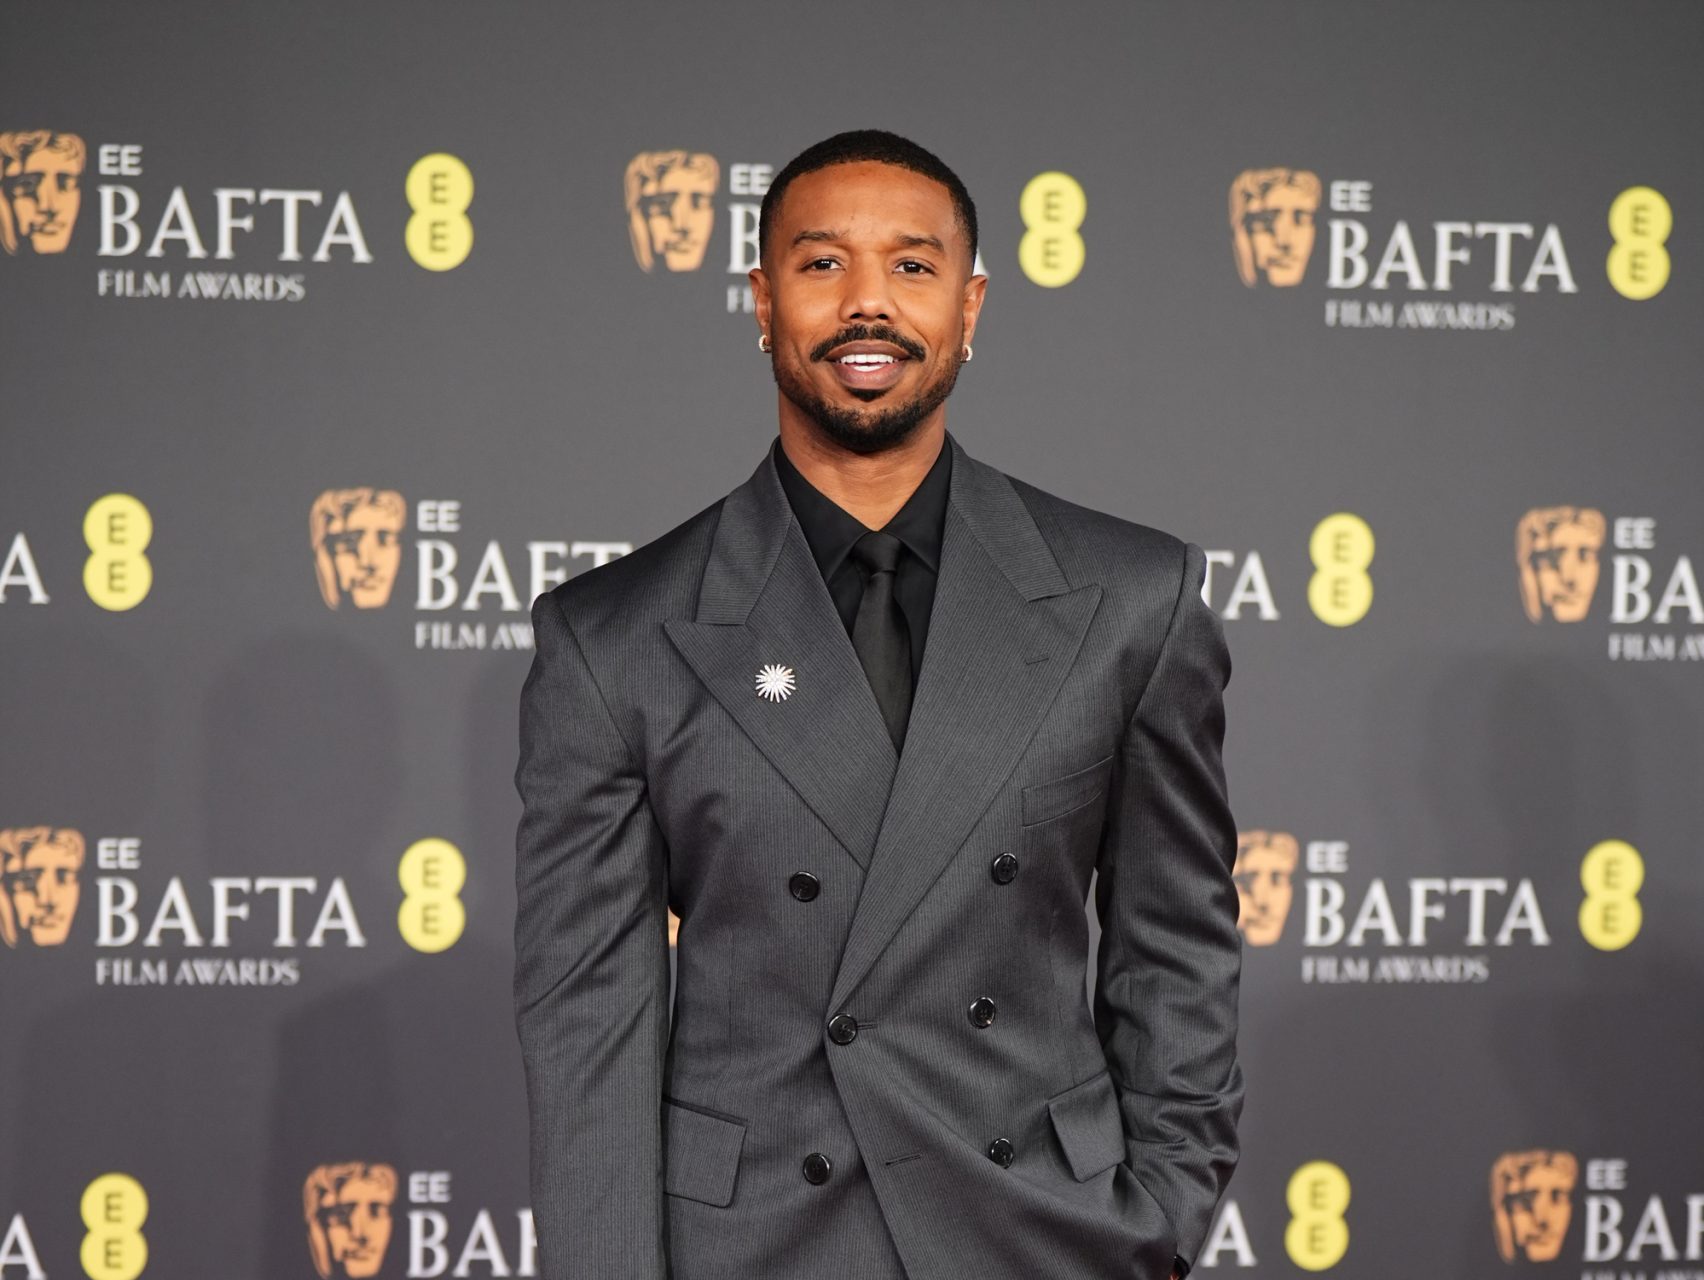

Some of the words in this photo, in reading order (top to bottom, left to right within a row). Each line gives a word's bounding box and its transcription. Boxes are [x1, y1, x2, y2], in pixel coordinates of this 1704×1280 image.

[98, 144, 142, 176] EE
[729, 163, 773, 196] EE
[1329, 180, 1372, 212] EE
[98, 185, 372, 263] BAFTA
[1327, 219, 1577, 293] BAFTA
[97, 269, 171, 298] FILM
[178, 272, 306, 301] AWARDS
[1325, 300, 1394, 328] FILM
[1398, 302, 1515, 330] AWARDS
[417, 500, 460, 533] EE
[1613, 517, 1655, 549] EE
[415, 621, 486, 649] FILM
[97, 838, 140, 870] EE
[1306, 841, 1348, 873] EE
[97, 877, 365, 947] BAFTA
[1303, 878, 1549, 947] BAFTA
[95, 958, 168, 985] FILM
[175, 959, 300, 985] AWARDS
[1301, 956, 1370, 983] FILM
[1374, 956, 1489, 983] AWARDS
[408, 1172, 450, 1203] EE
[1586, 1159, 1626, 1190] EE
